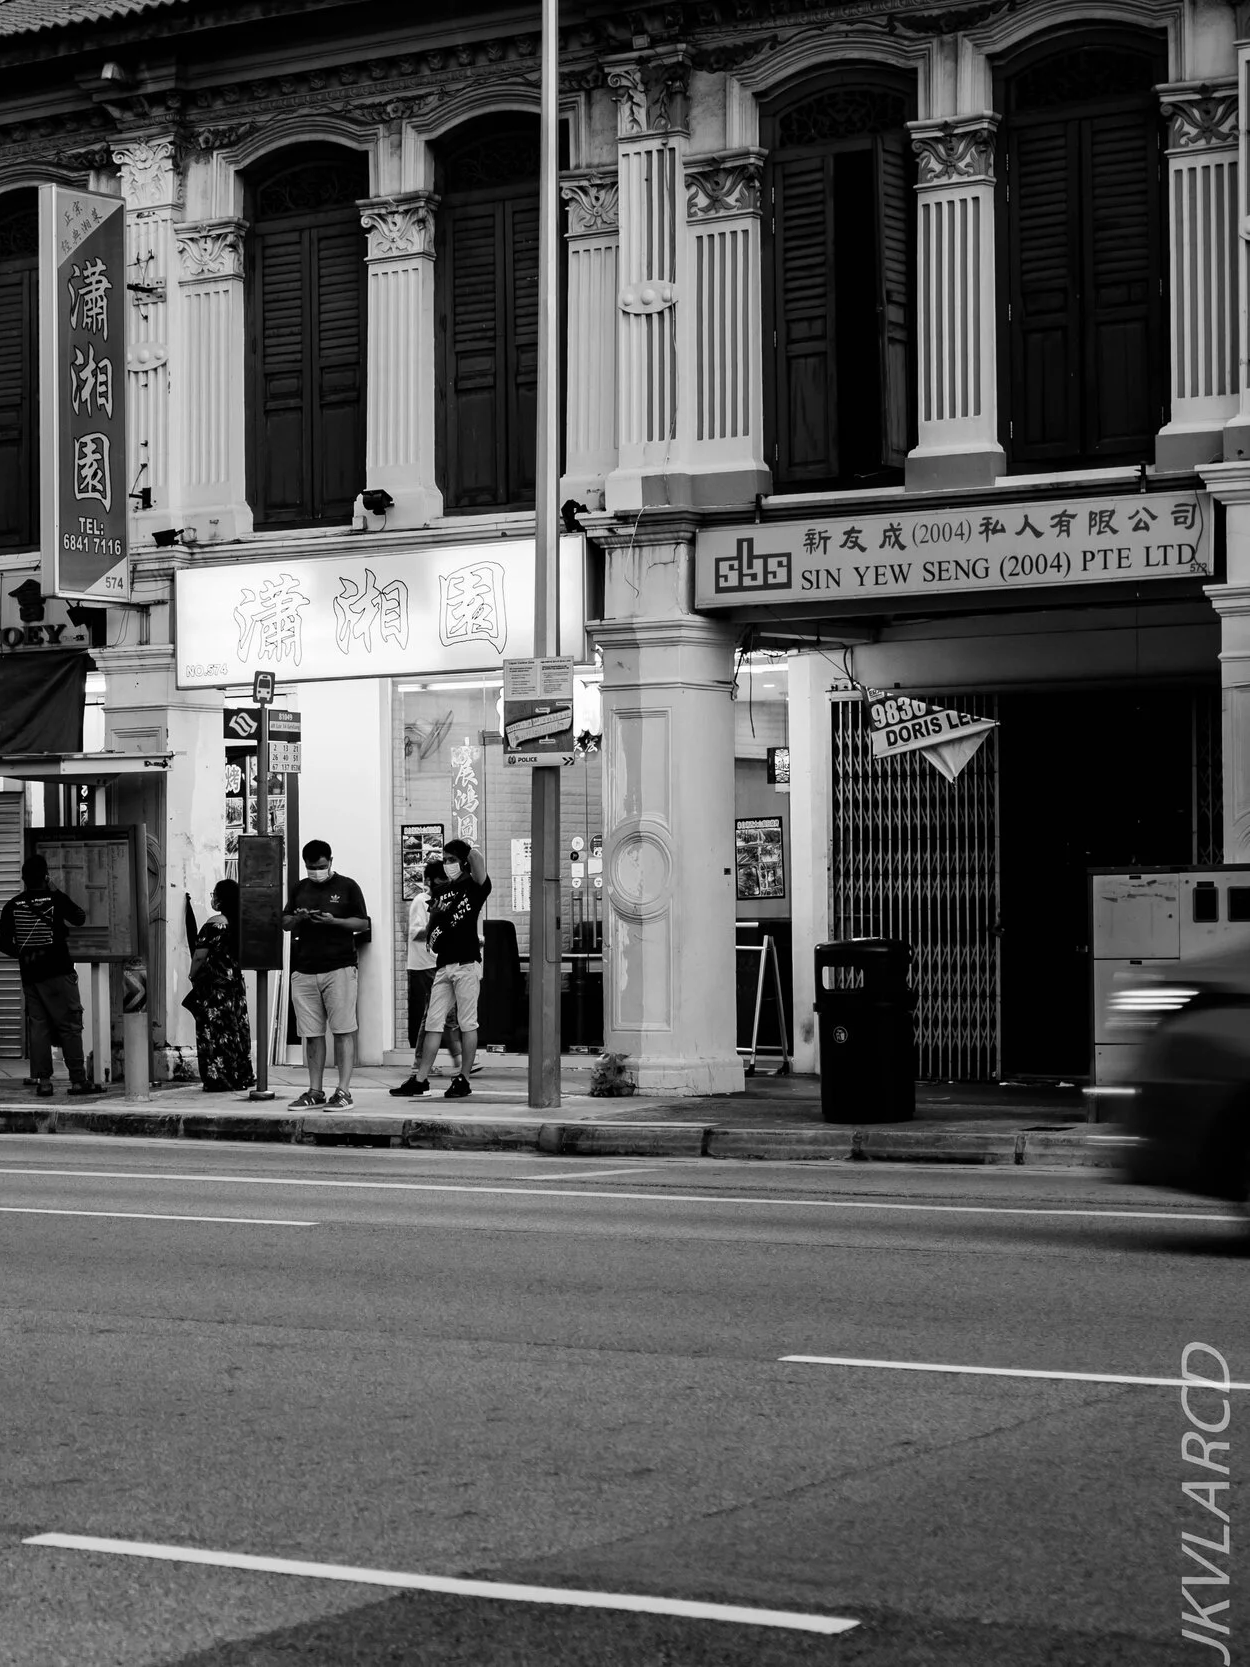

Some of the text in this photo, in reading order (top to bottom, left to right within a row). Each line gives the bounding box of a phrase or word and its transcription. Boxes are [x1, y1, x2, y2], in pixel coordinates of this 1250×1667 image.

[78, 517, 105, 536] TEL:
[63, 533, 122, 556] 6841 7116
[801, 543, 1196, 591] SIN YEW SENG (2004) PTE LTD
[105, 576, 124, 590] 574
[185, 663, 229, 679] NO.574
[885, 716, 943, 747] DORIS
[272, 753, 278, 761] 26
[283, 744, 289, 752] 13
[293, 745, 299, 753] 21
